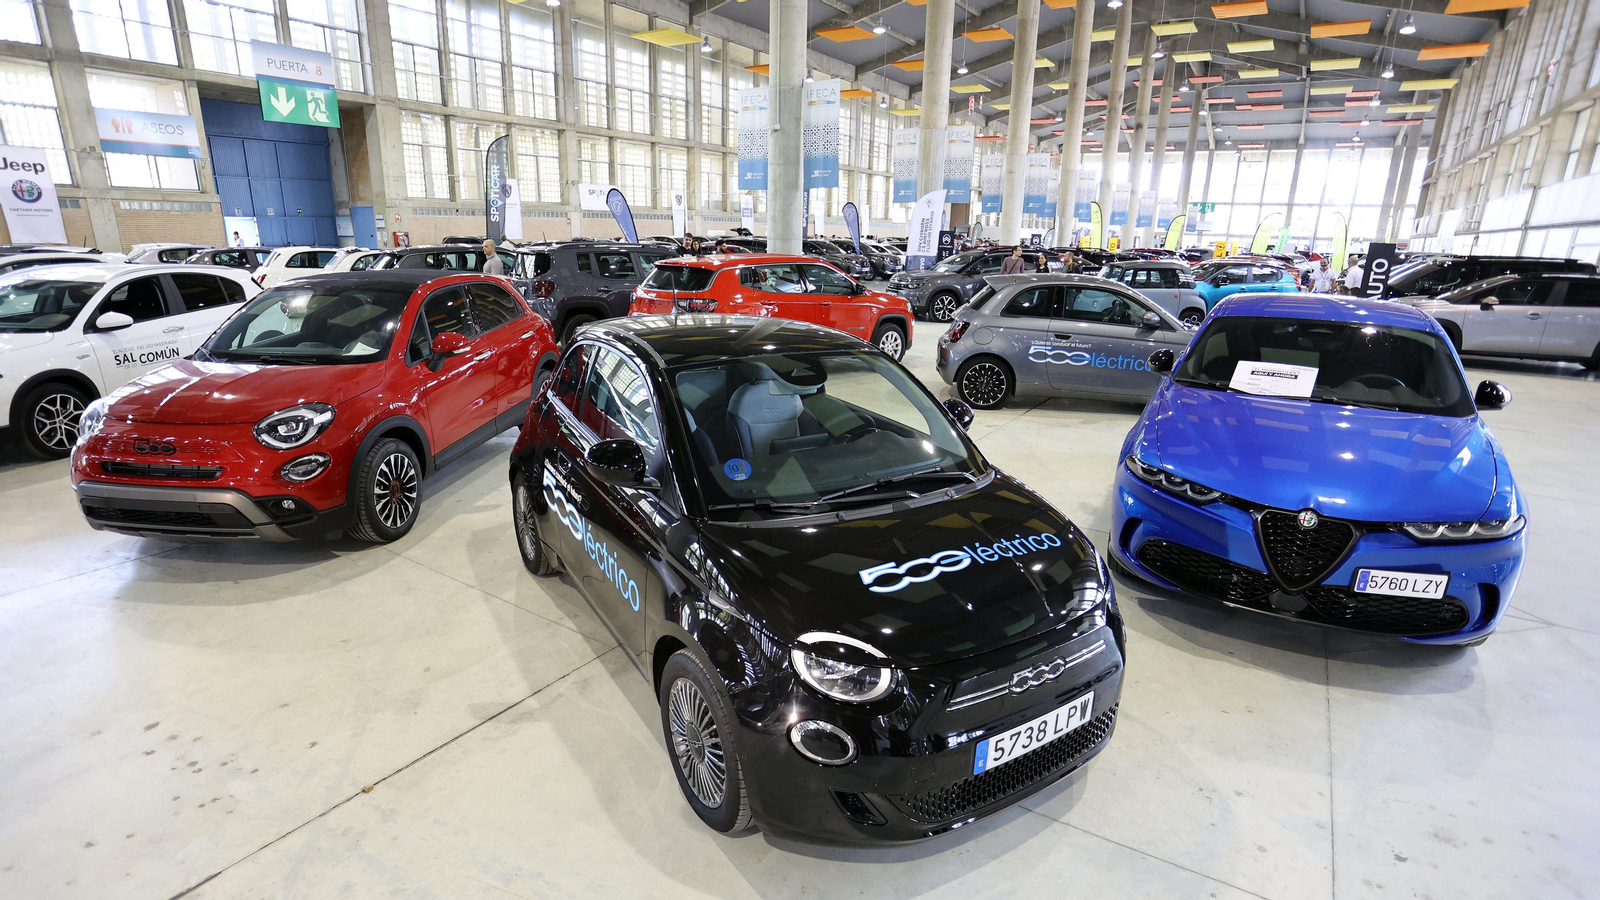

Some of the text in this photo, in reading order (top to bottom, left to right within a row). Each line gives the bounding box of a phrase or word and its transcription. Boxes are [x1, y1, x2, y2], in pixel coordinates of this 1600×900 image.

[266, 58, 322, 76] PUERTA 8
[741, 95, 768, 104] IFECA
[806, 88, 836, 99] IFECA
[142, 122, 184, 136] ASEOS
[0, 157, 45, 174] Jeep
[114, 346, 179, 365] SAL COMÚN
[133, 438, 176, 456] 500
[1368, 576, 1443, 594] 5760 LZY
[1010, 658, 1066, 692] 500
[992, 698, 1090, 762] 5738 LPW
